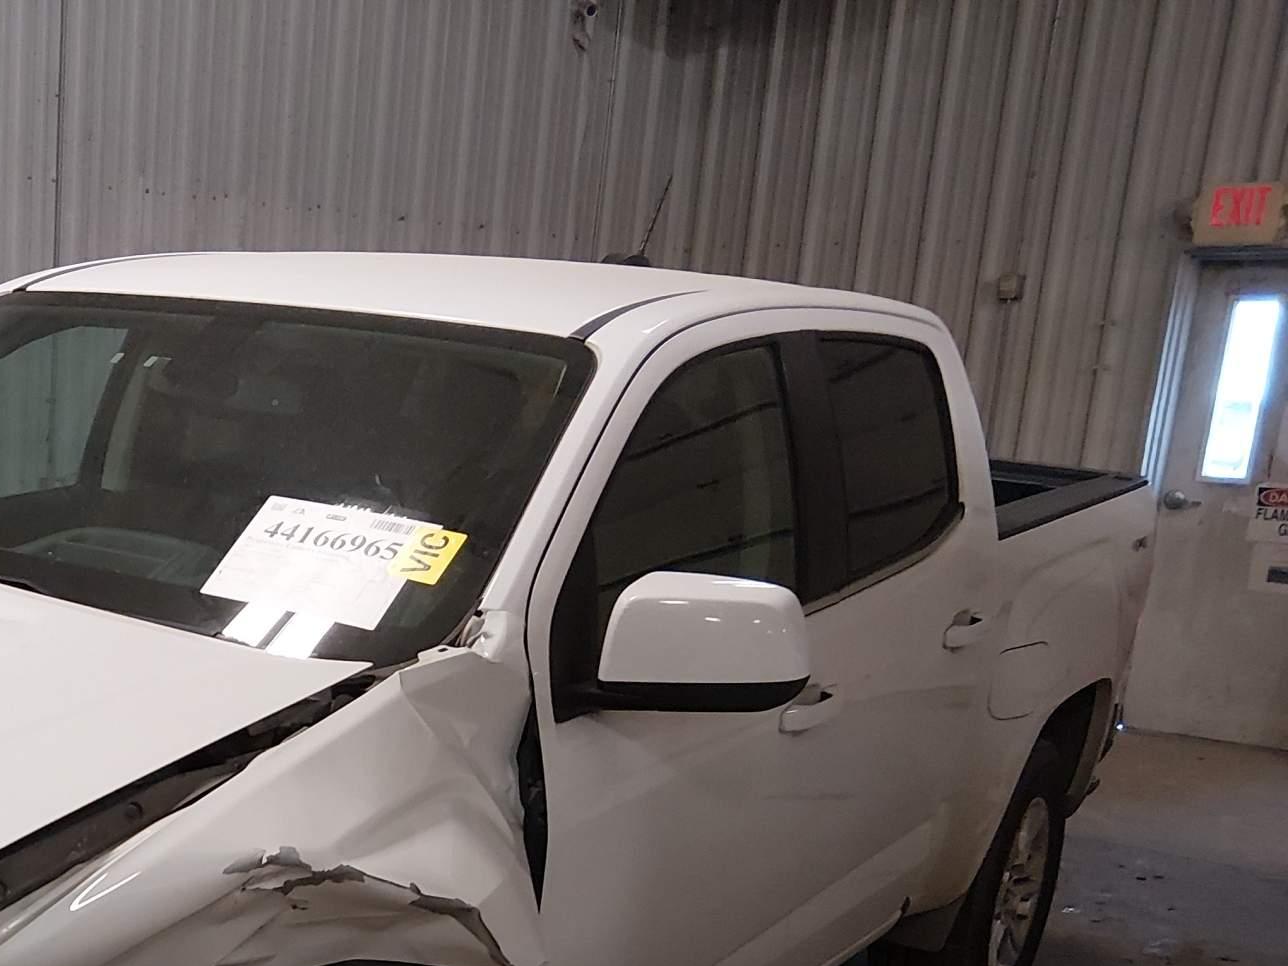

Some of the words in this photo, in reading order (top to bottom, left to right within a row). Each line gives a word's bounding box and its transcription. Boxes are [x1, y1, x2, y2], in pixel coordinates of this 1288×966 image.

[1210, 186, 1272, 227] EXIT
[264, 520, 404, 561] 44166965
[400, 532, 450, 573] VIC
